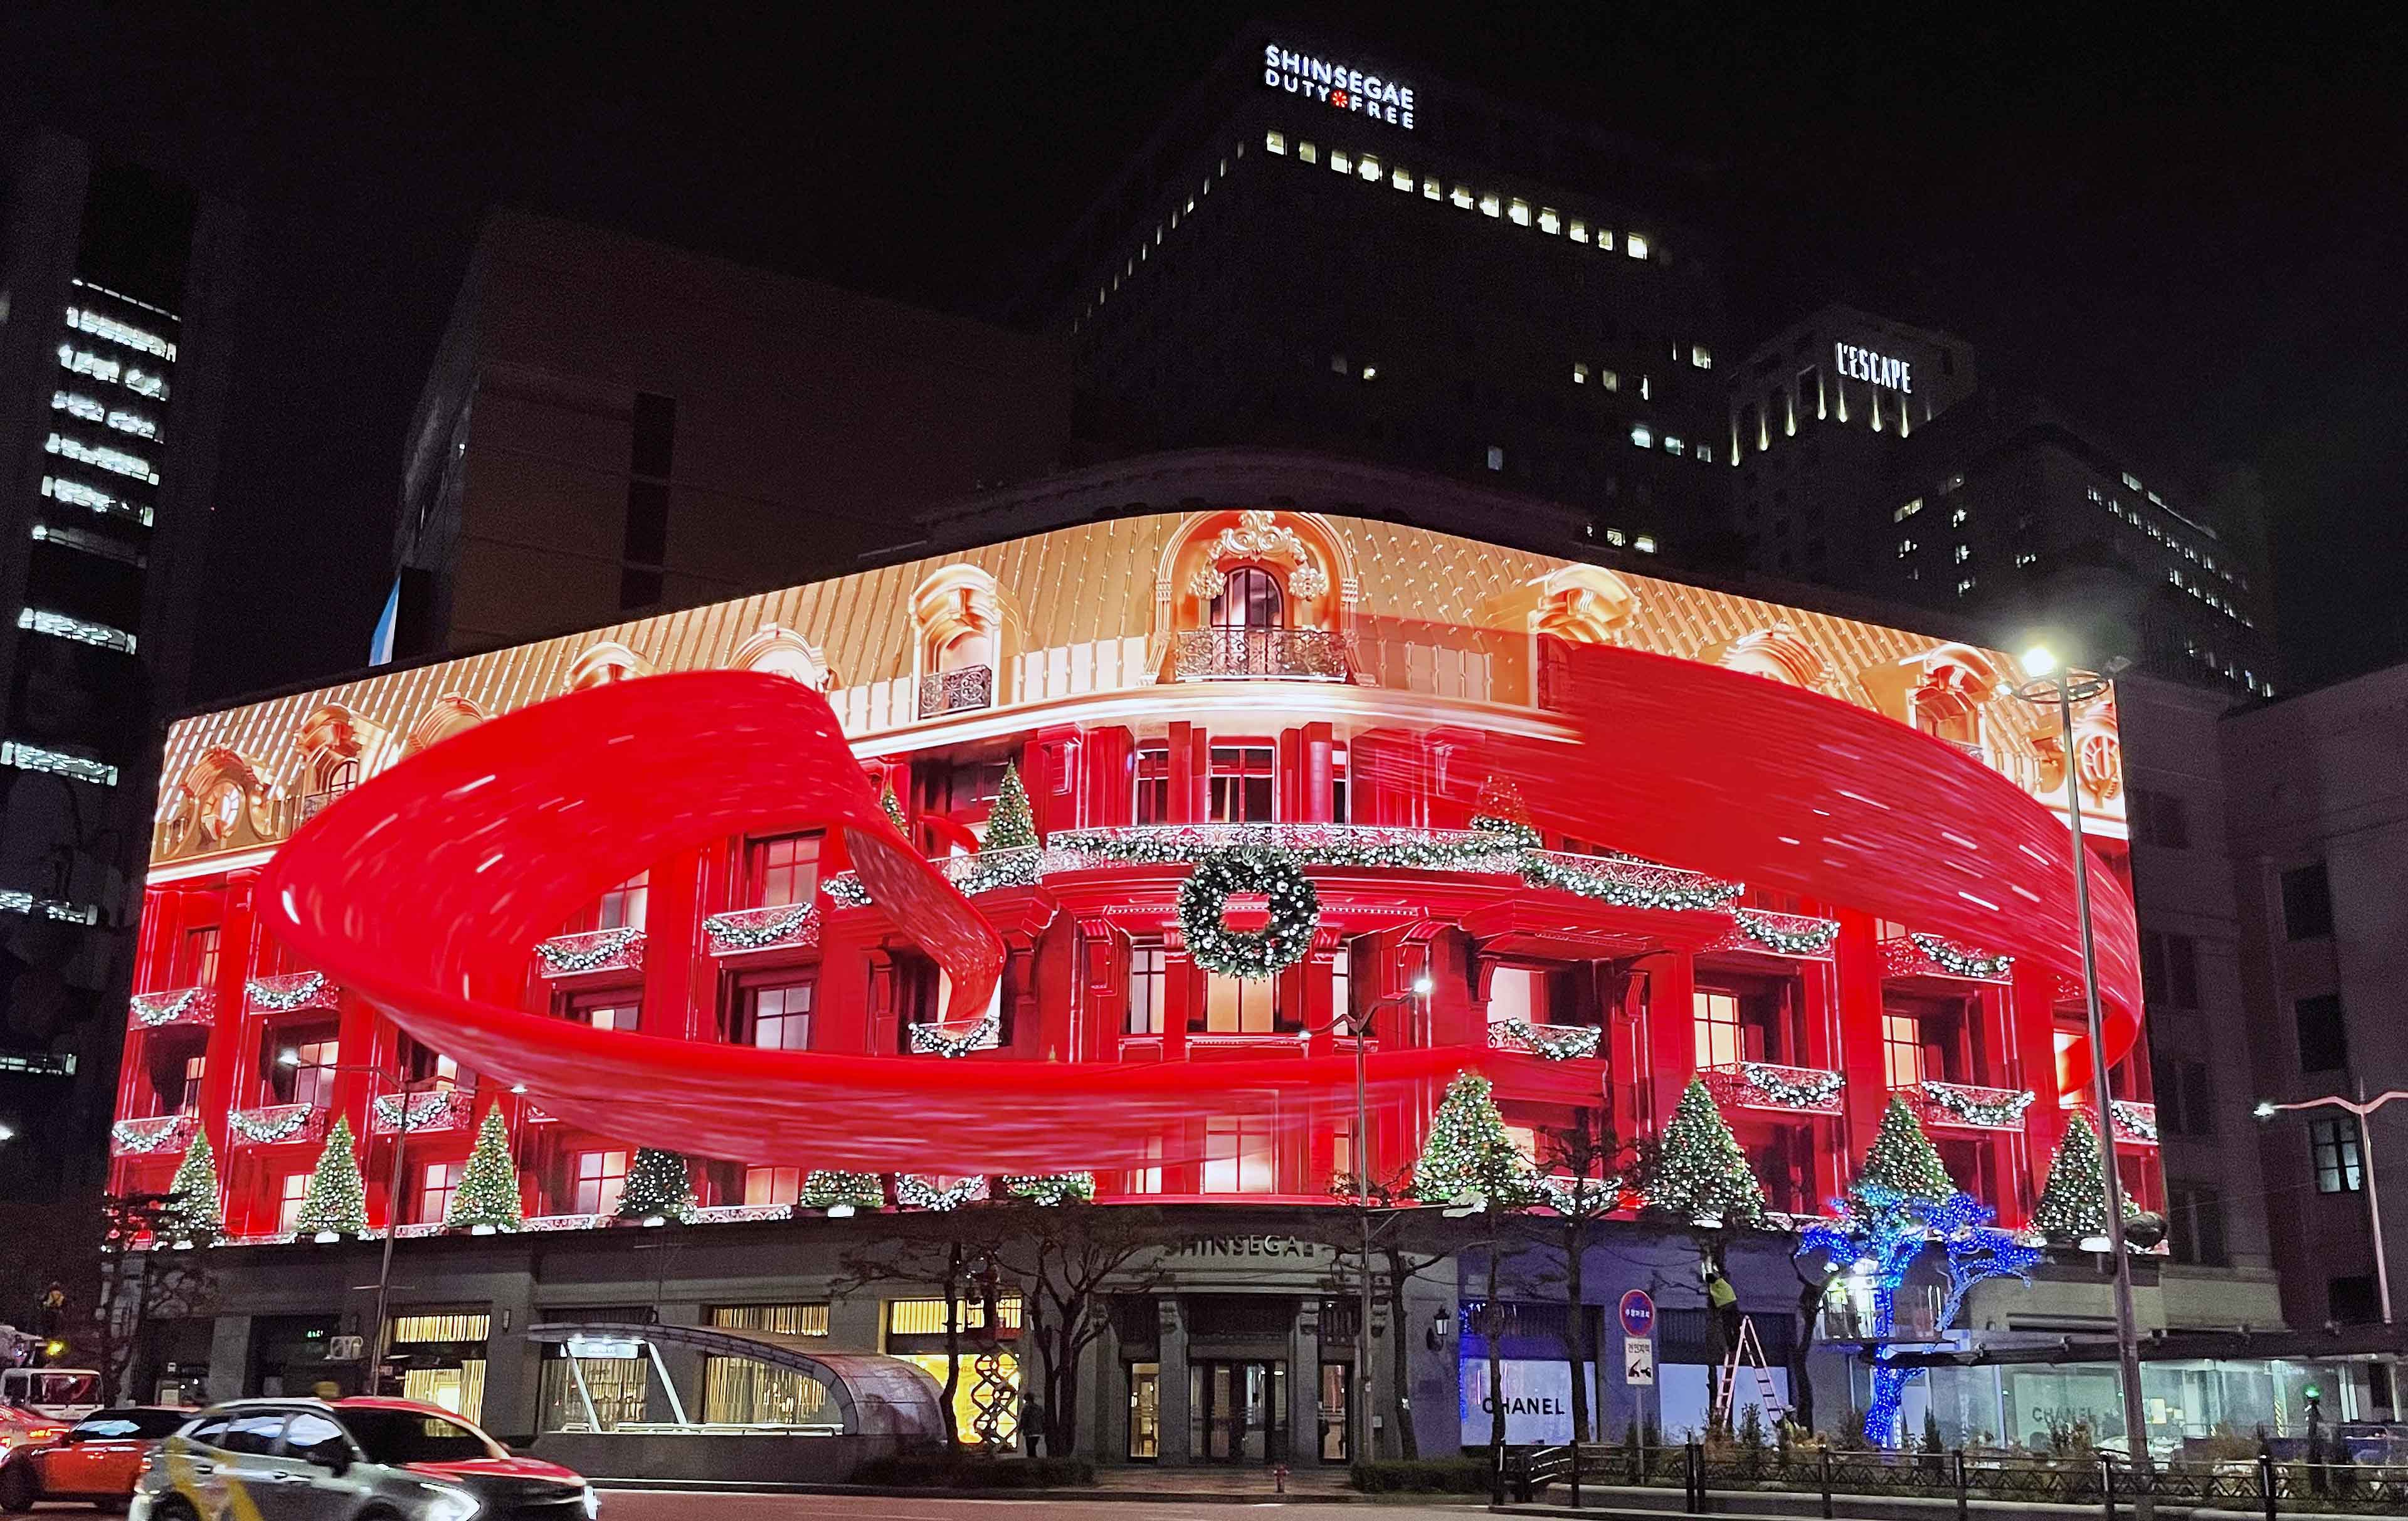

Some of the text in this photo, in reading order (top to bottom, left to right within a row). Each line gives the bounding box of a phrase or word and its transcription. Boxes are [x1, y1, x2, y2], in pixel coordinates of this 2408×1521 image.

[1265, 45, 1414, 111] SHINSEGAE
[1265, 69, 1414, 130] DUTY FREE
[1837, 342, 1911, 394] L'ESCAPE
